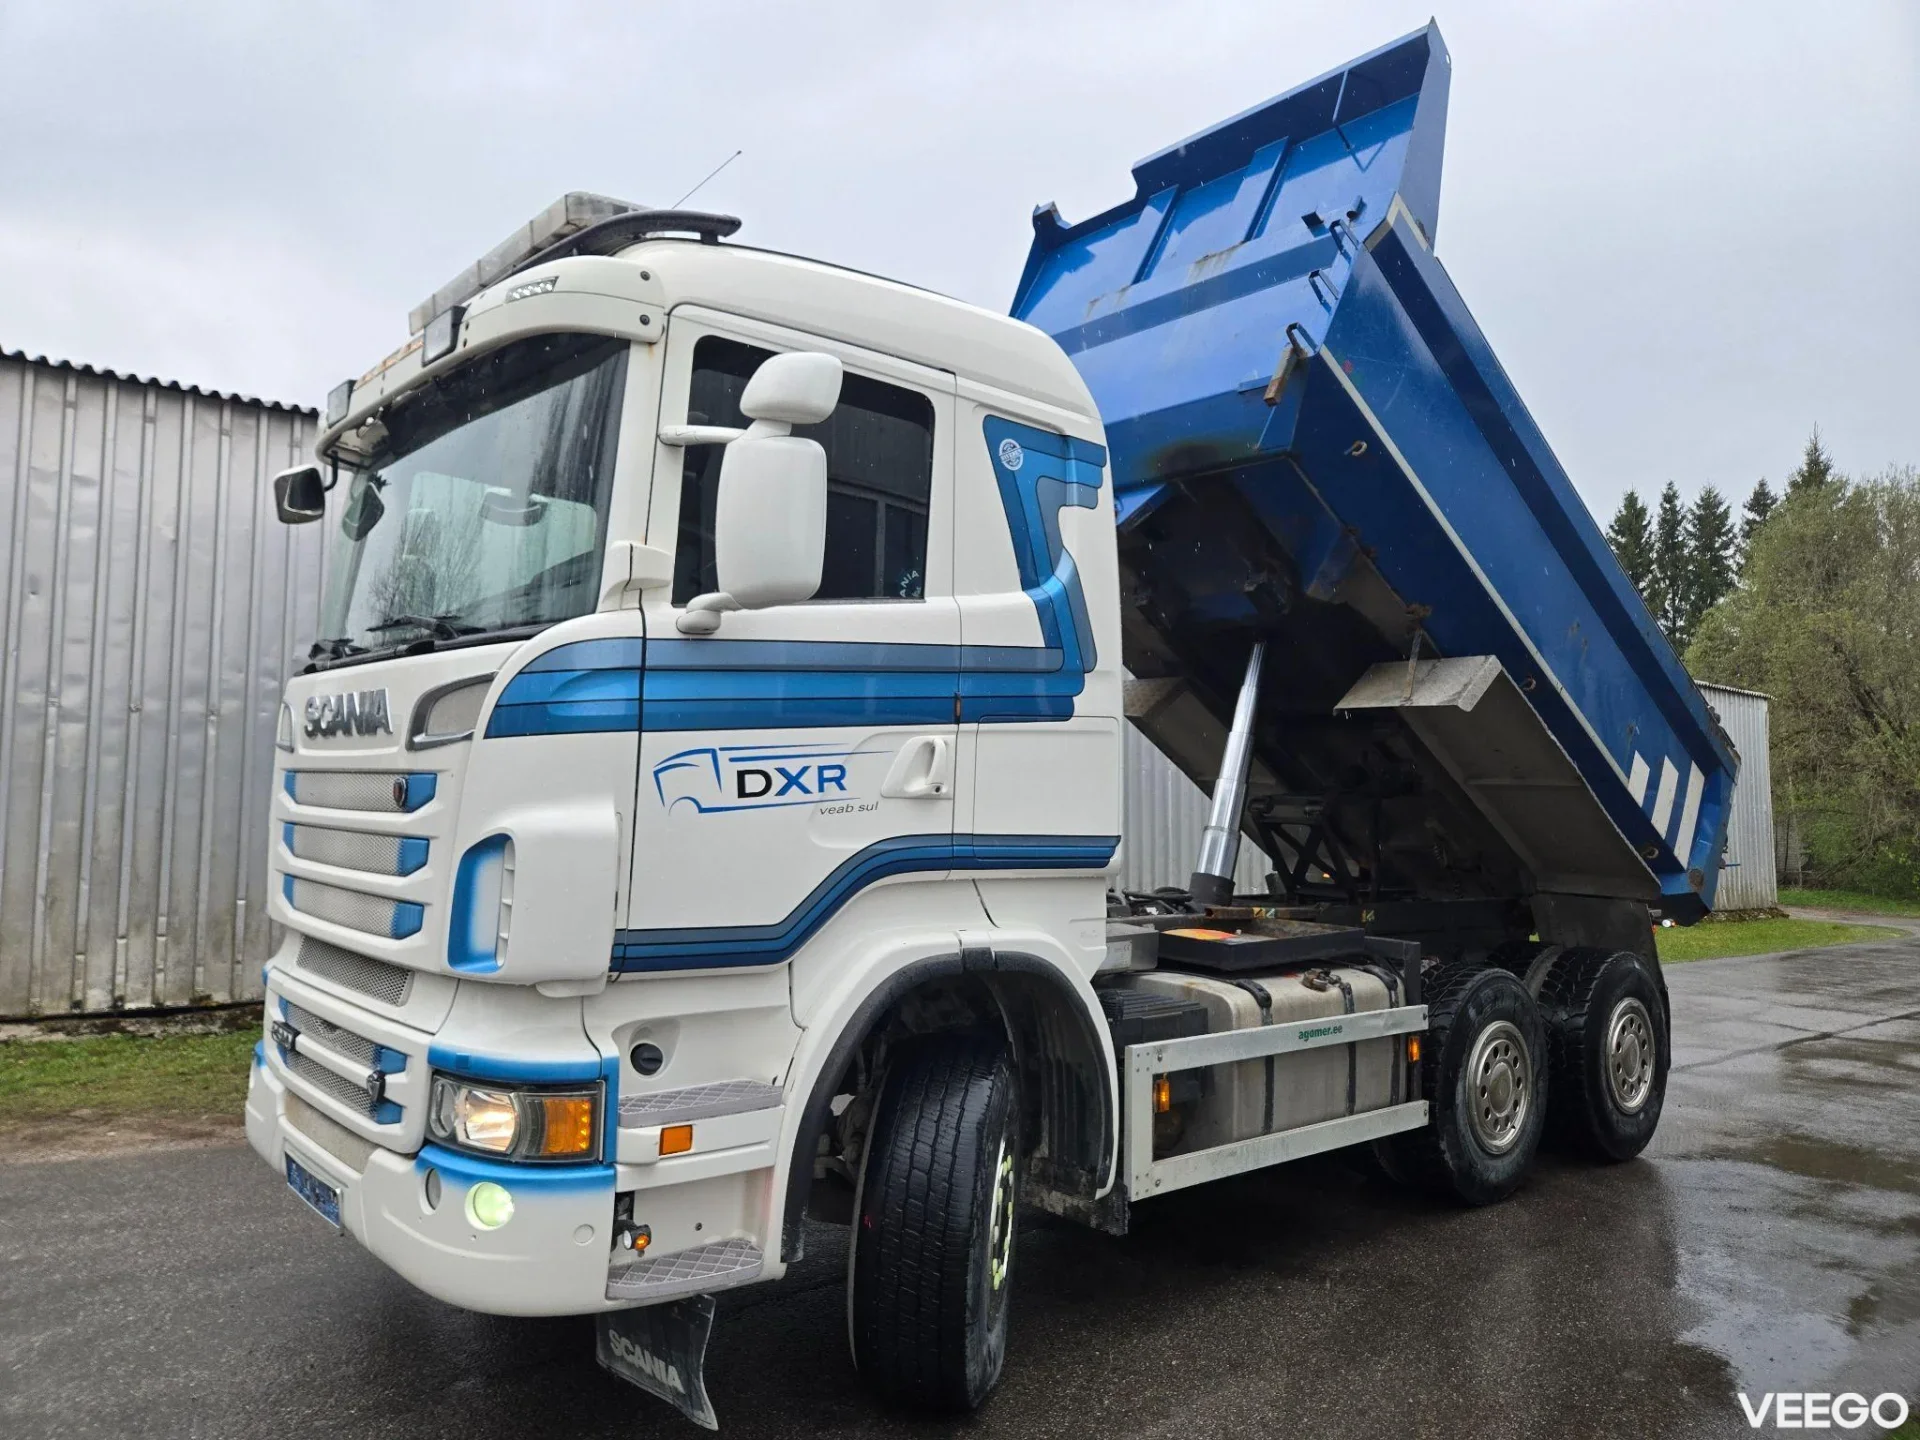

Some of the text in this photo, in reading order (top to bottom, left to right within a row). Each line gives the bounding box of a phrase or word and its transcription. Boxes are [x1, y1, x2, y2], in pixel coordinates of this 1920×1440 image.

[304, 688, 393, 737] SCANIA
[737, 764, 847, 798] DXR
[819, 801, 880, 815] veab sul
[1298, 1024, 1343, 1042] agomer.ee
[609, 1329, 686, 1394] SCANIA
